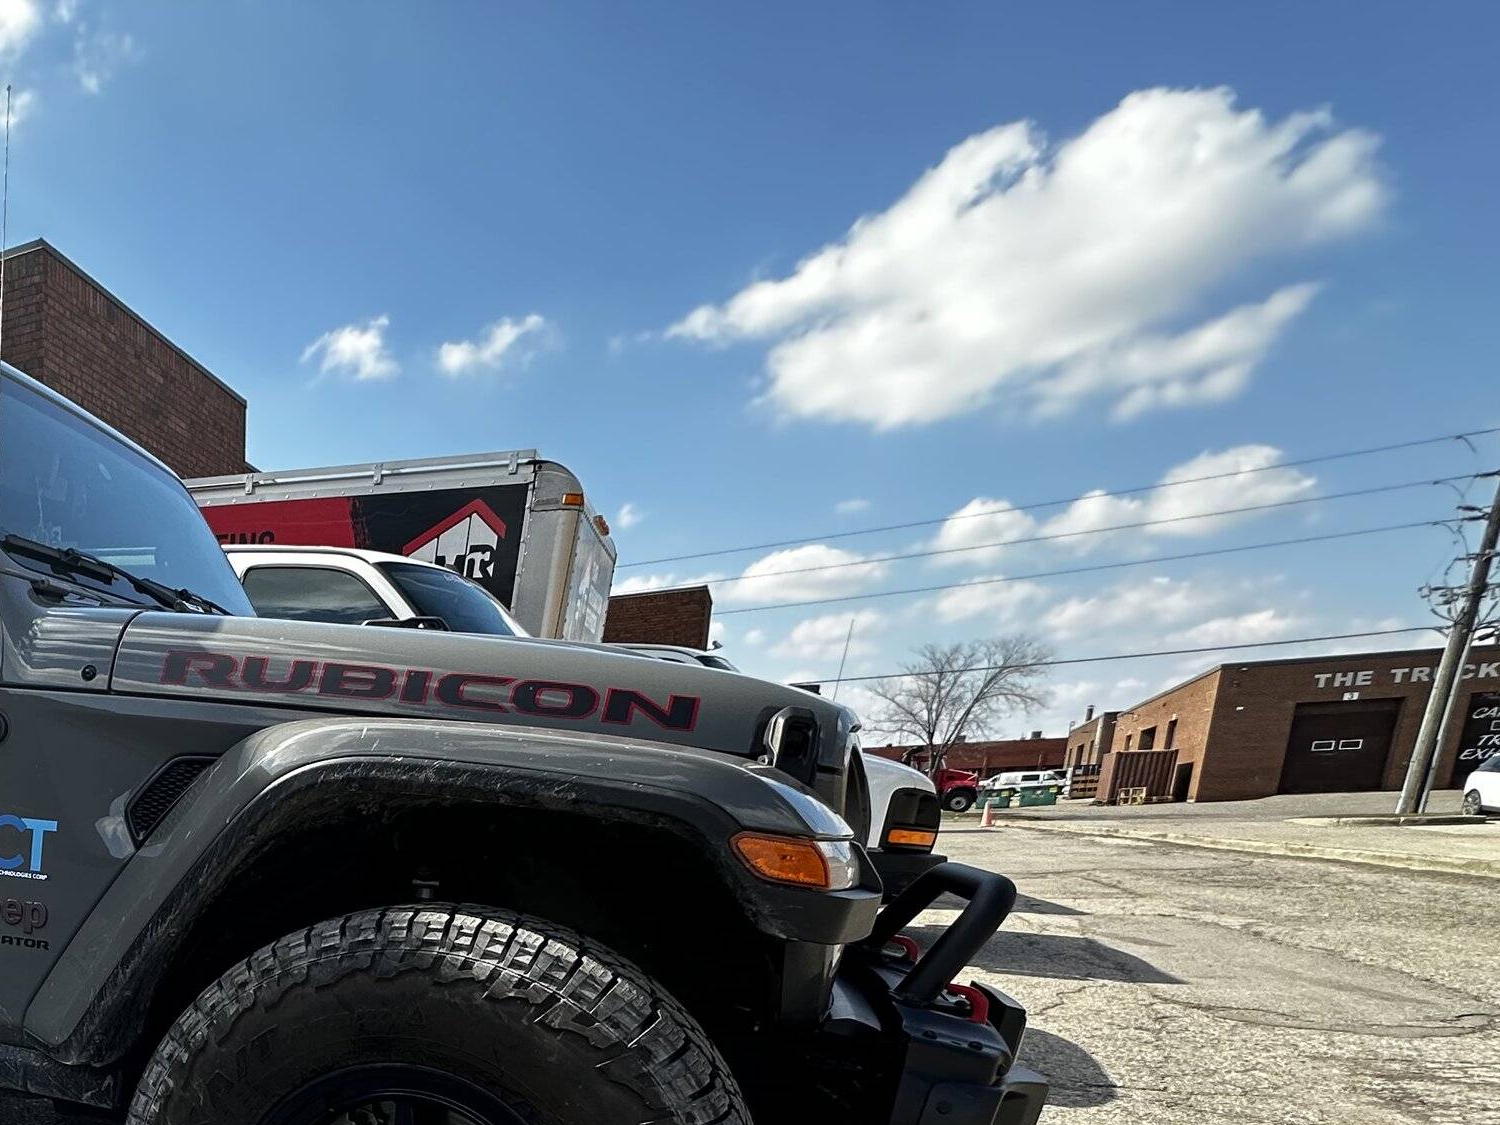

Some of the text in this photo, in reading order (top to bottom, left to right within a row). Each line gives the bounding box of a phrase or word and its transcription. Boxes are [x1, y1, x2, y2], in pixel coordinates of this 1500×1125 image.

[159, 650, 701, 733] RUBICON
[1314, 662, 1500, 689] THE TRCK
